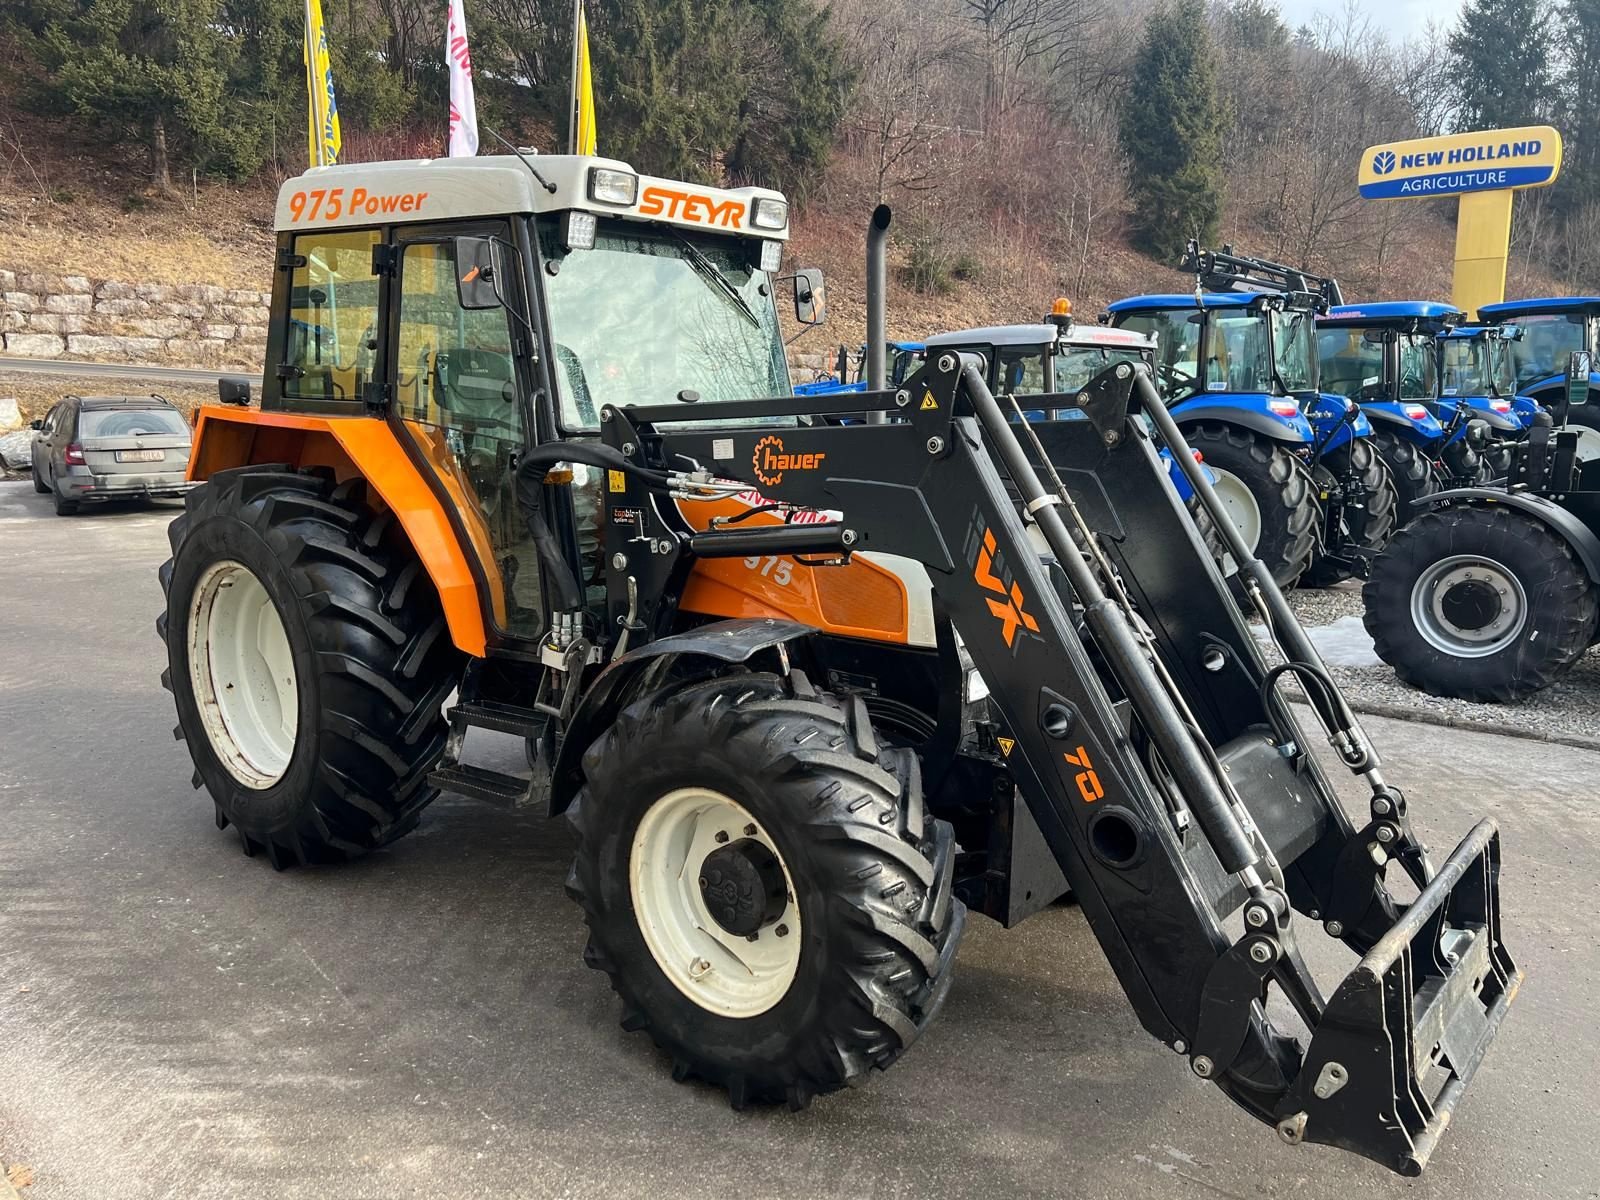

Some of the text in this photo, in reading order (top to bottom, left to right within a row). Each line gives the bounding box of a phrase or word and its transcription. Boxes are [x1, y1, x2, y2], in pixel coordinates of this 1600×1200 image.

[1400, 140, 1542, 169] NEW HOLLAND
[1400, 171, 1507, 192] AGRICULTURE
[289, 188, 428, 222] 975 Power
[638, 187, 746, 229] STEYR
[763, 447, 826, 470] hauer
[1063, 745, 1105, 802] 70
